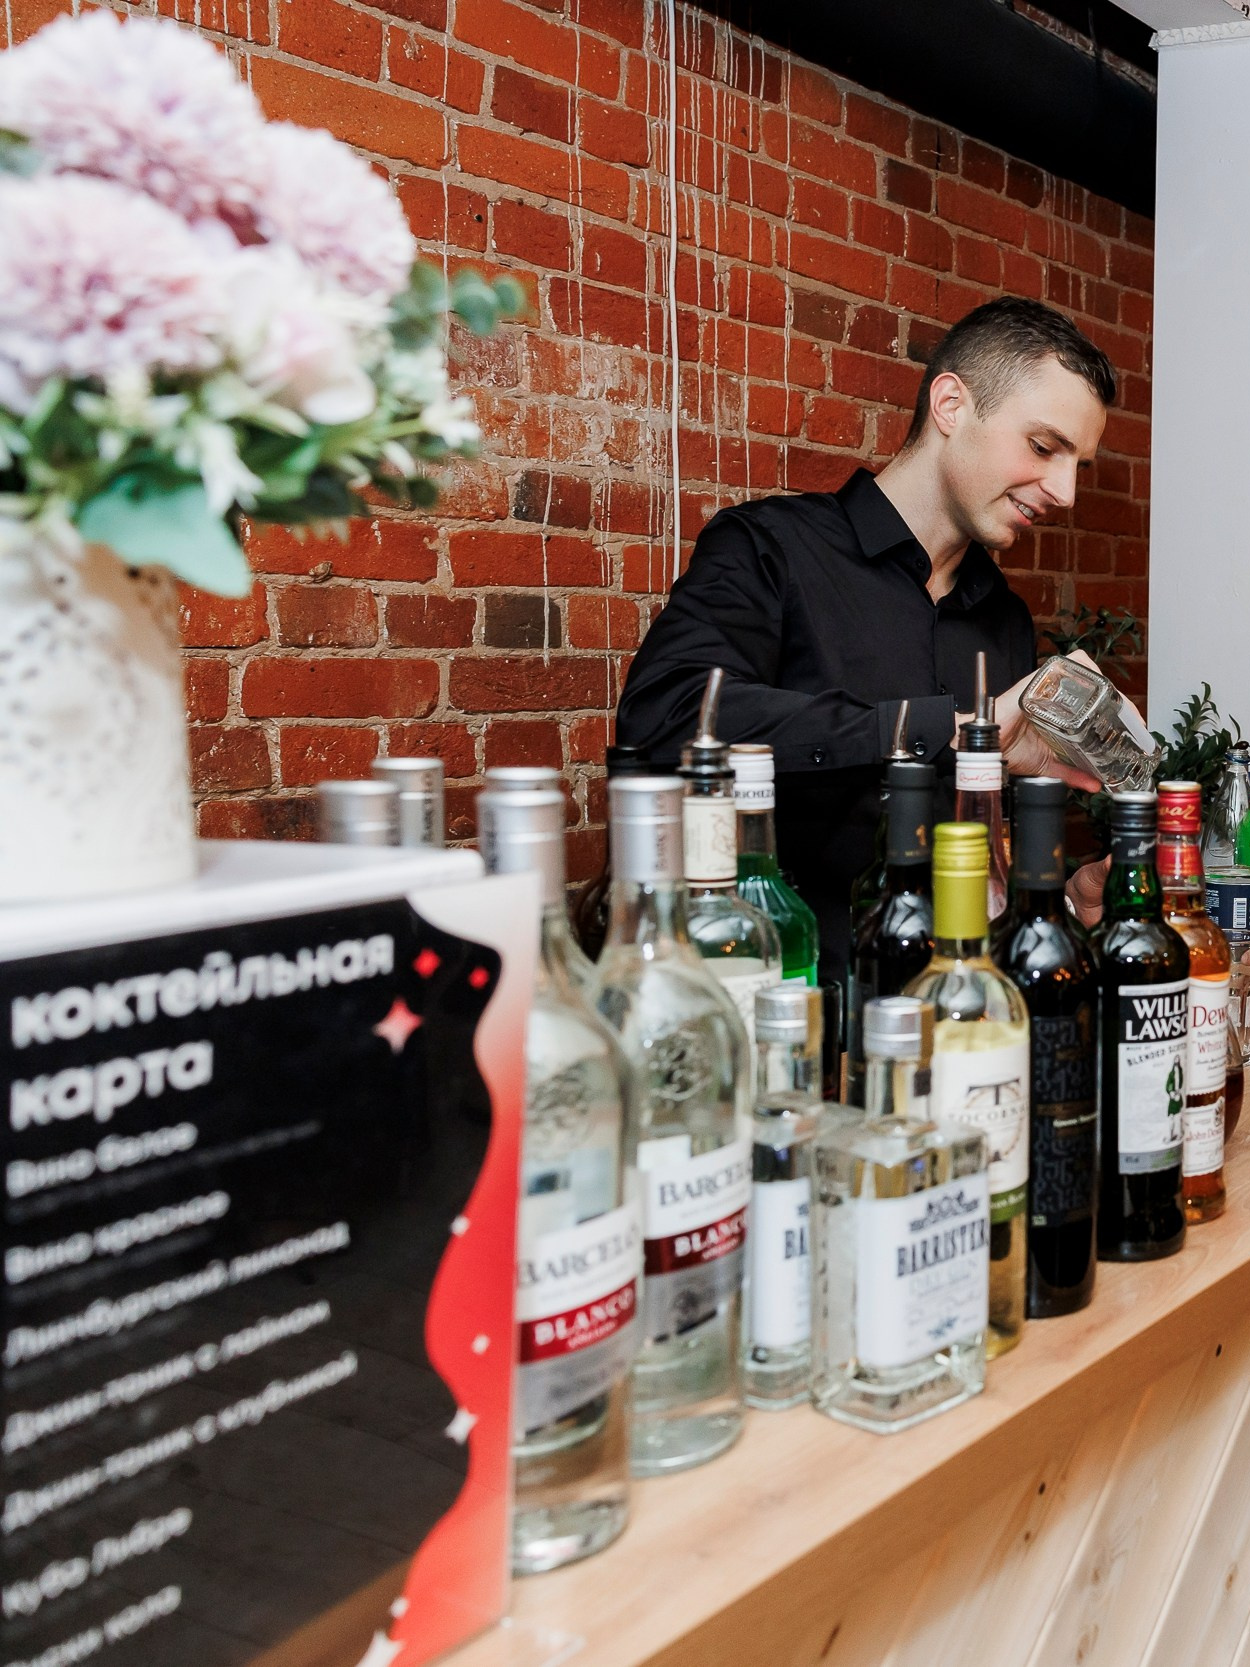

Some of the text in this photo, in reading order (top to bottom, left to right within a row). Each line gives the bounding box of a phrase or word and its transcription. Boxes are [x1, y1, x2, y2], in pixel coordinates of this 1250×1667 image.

[10, 1040, 214, 1131] карта
[7, 1149, 96, 1198] Вино
[5, 1232, 93, 1285] Вино
